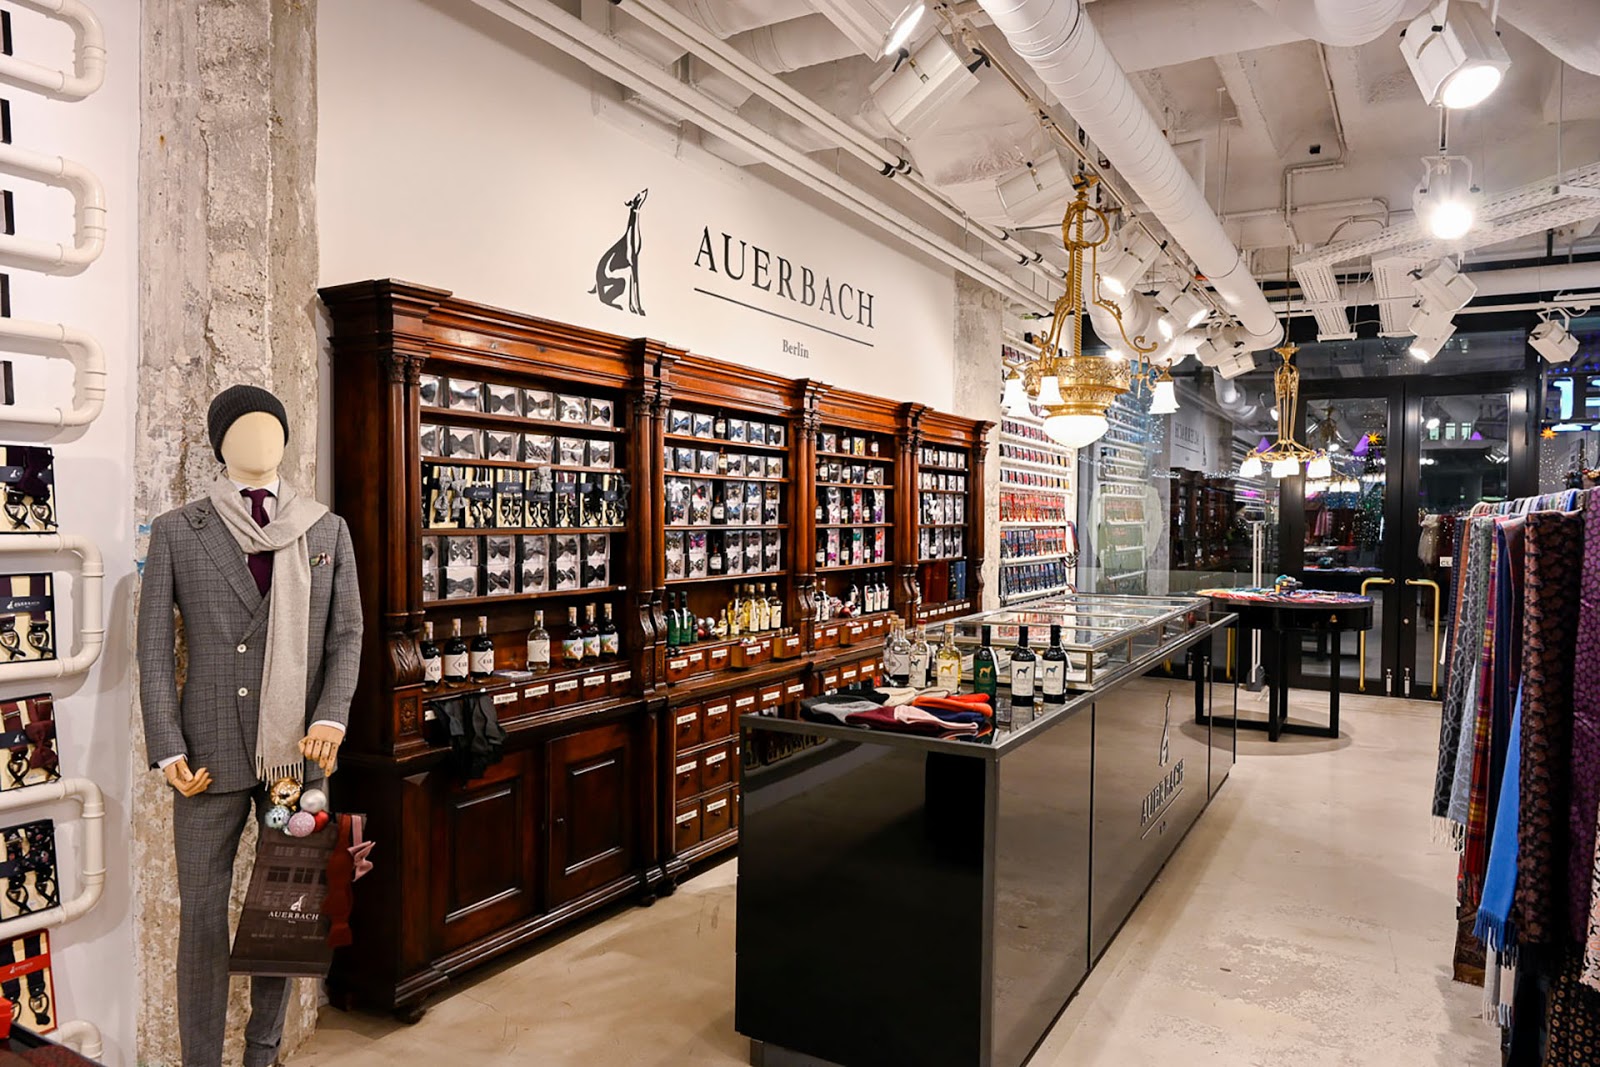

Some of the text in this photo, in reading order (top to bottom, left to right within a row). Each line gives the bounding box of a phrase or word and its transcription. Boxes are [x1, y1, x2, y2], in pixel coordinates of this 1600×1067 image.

[694, 225, 875, 329] AUERBACH
[782, 339, 809, 359] Berlin
[268, 911, 319, 921] AUERBACH
